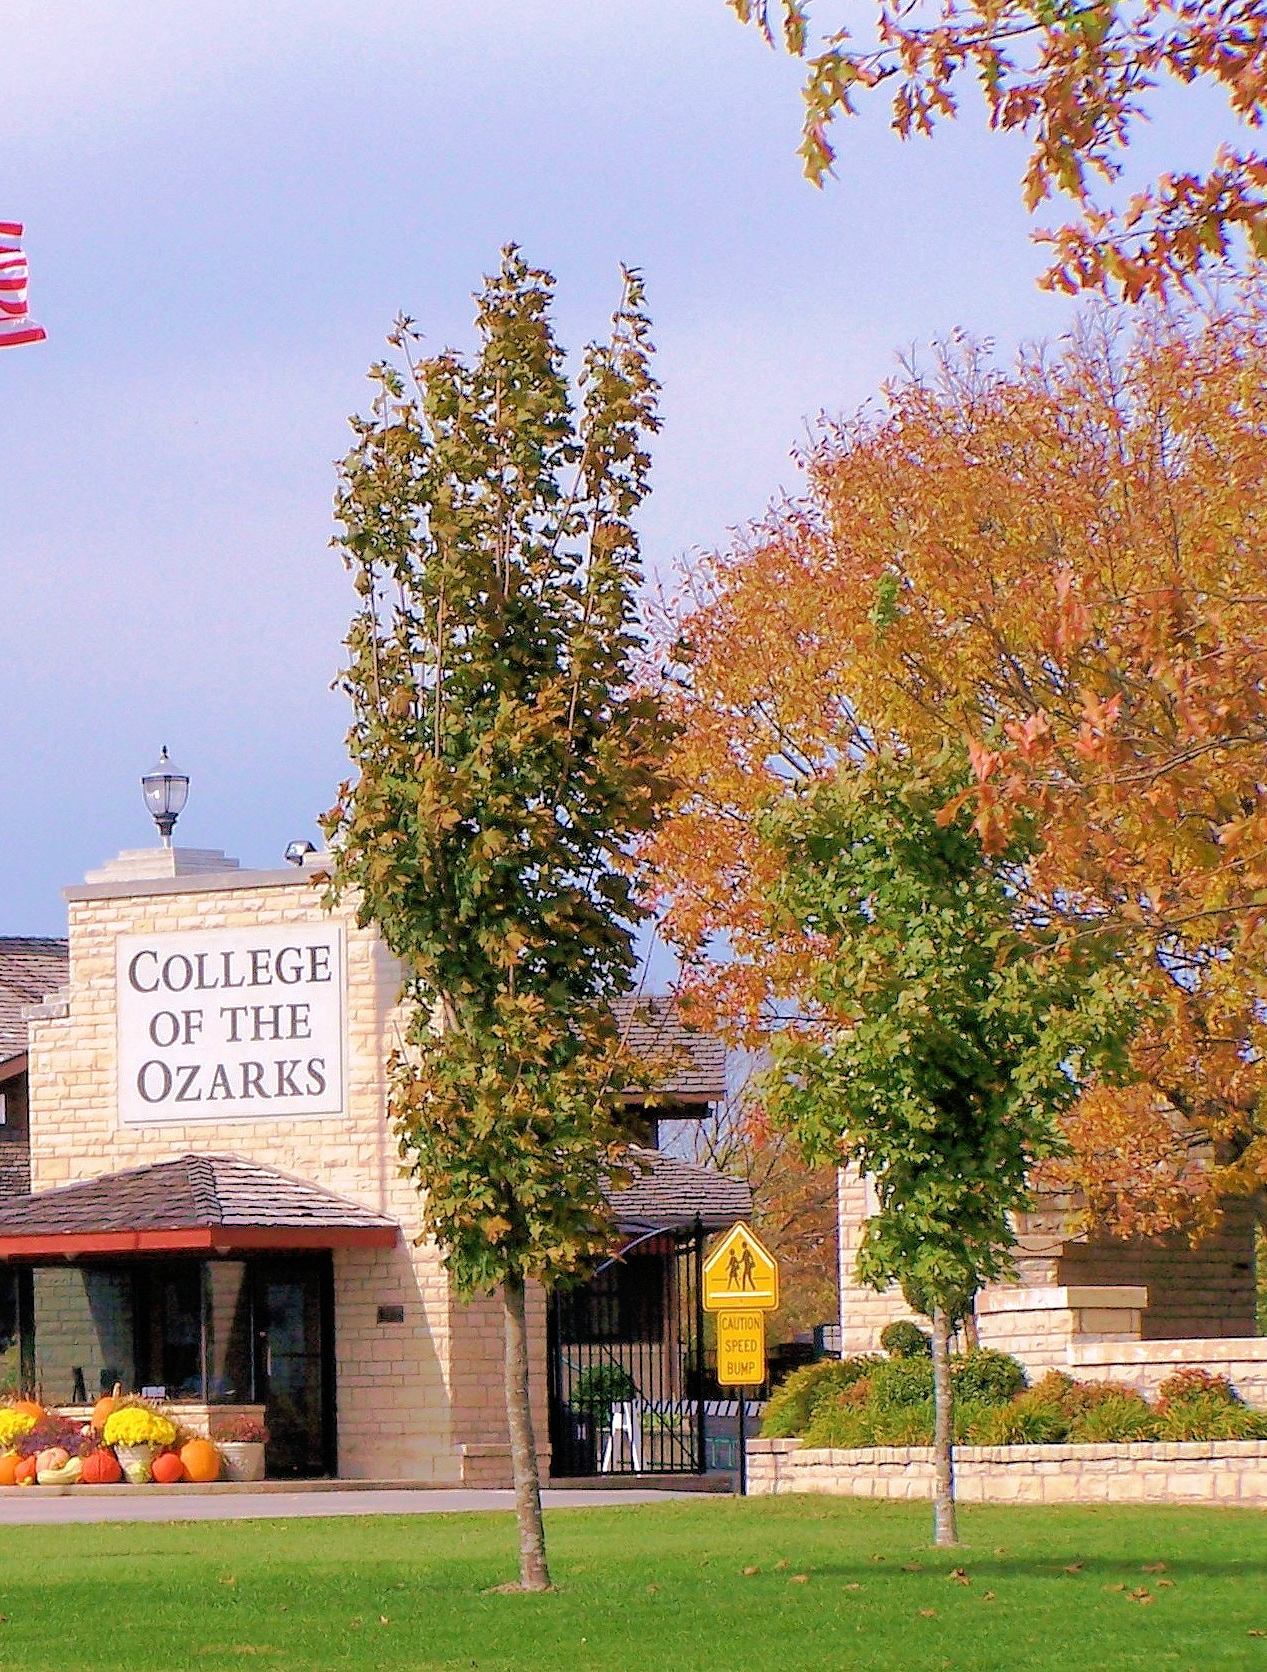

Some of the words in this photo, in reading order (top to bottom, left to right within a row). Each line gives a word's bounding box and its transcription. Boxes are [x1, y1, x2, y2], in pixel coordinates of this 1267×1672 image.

[128, 945, 332, 993] COLLEGE
[149, 1009, 203, 1047] OF
[220, 1003, 312, 1042] THE
[137, 1058, 326, 1103] OZARKS
[721, 1317, 760, 1331] CAUTION
[725, 1340, 758, 1353] SPEED
[727, 1361, 755, 1376] BUMP
